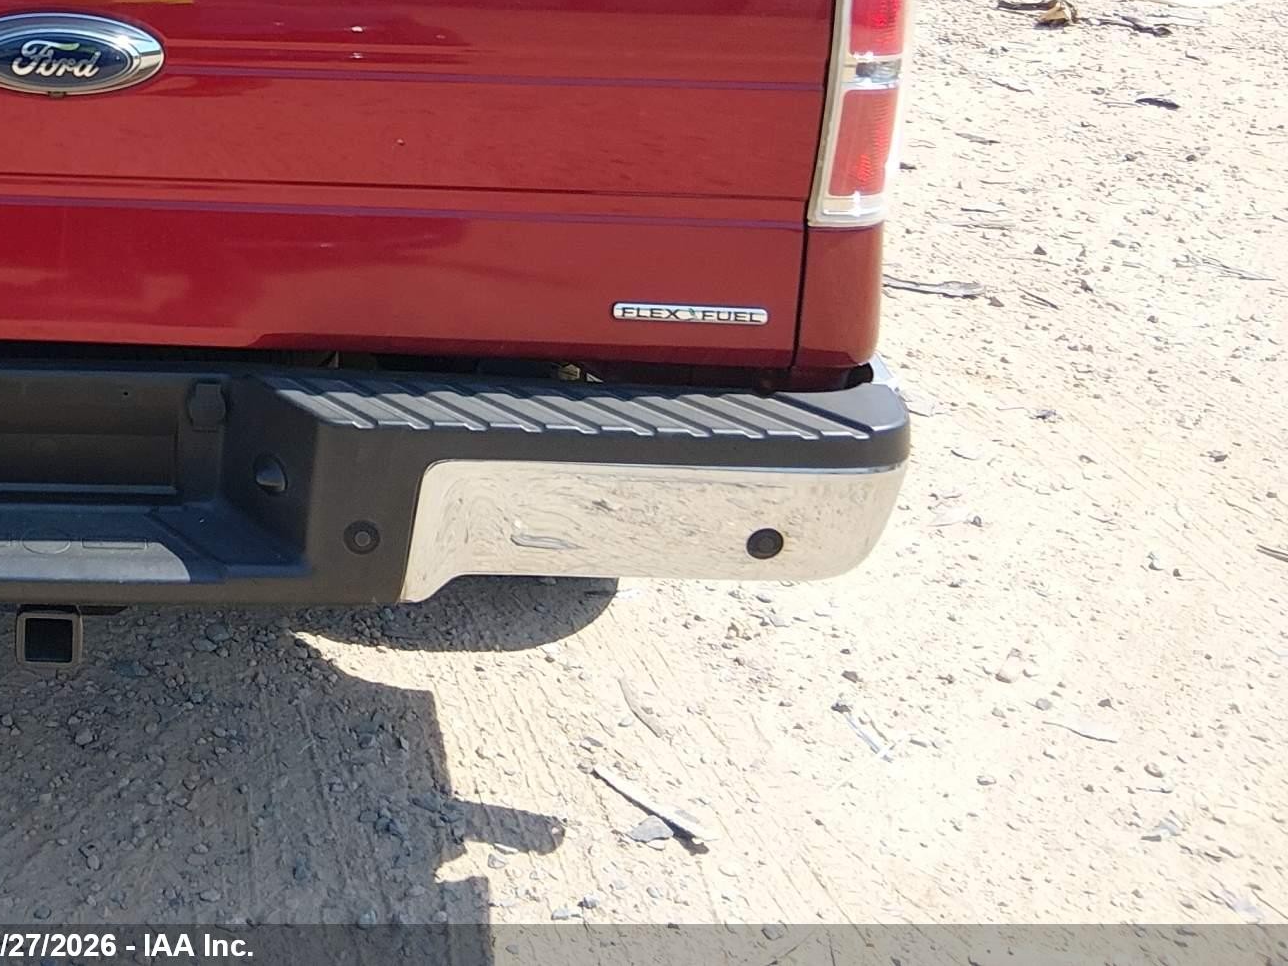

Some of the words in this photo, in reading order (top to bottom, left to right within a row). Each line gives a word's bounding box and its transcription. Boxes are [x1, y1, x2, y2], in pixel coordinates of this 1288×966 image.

[11, 39, 101, 77] Ford
[620, 306, 680, 320] FLEX
[701, 310, 762, 323] FUEL
